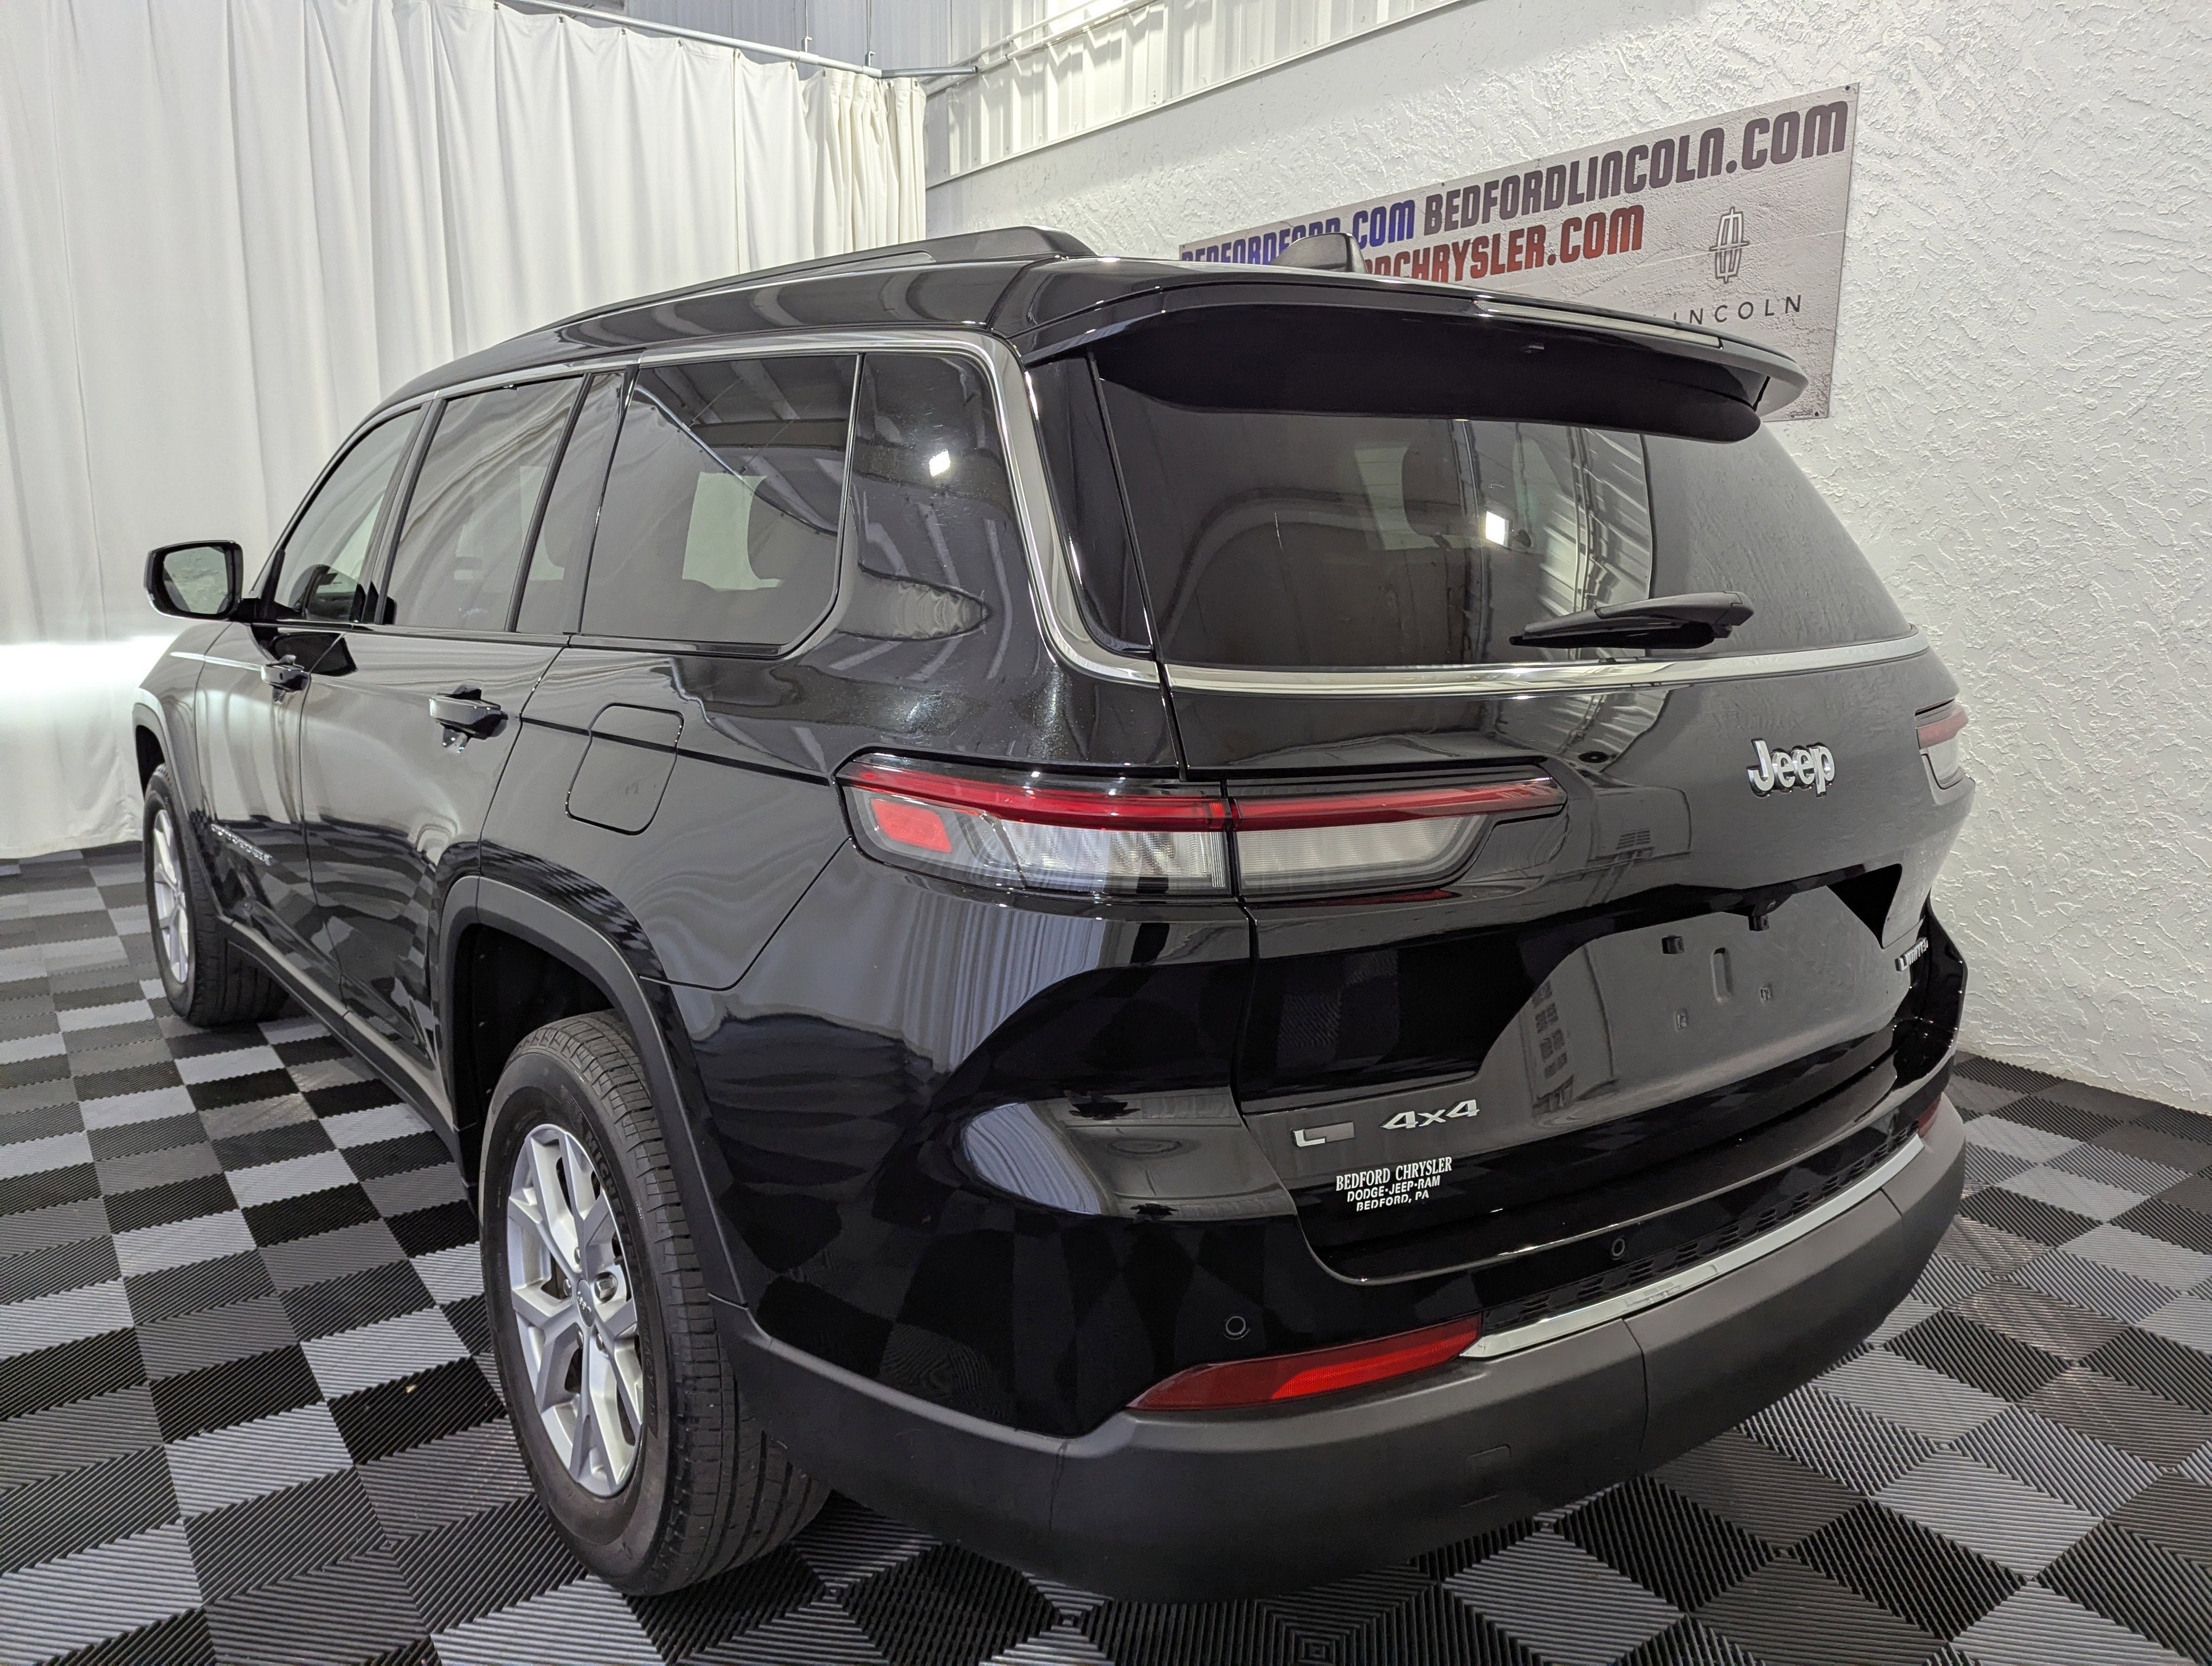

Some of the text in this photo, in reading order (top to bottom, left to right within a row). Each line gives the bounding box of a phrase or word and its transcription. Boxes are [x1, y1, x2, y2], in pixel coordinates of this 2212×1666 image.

[1423, 100, 1849, 236] BEDFORDLINCOLN.COM
[1747, 739, 1836, 797] Jeep
[1380, 1099, 1480, 1129] 4x4
[1336, 1156, 1452, 1191] BEDFORD CHRYSLER
[1356, 1189, 1429, 1212] BEDFORD, PA
